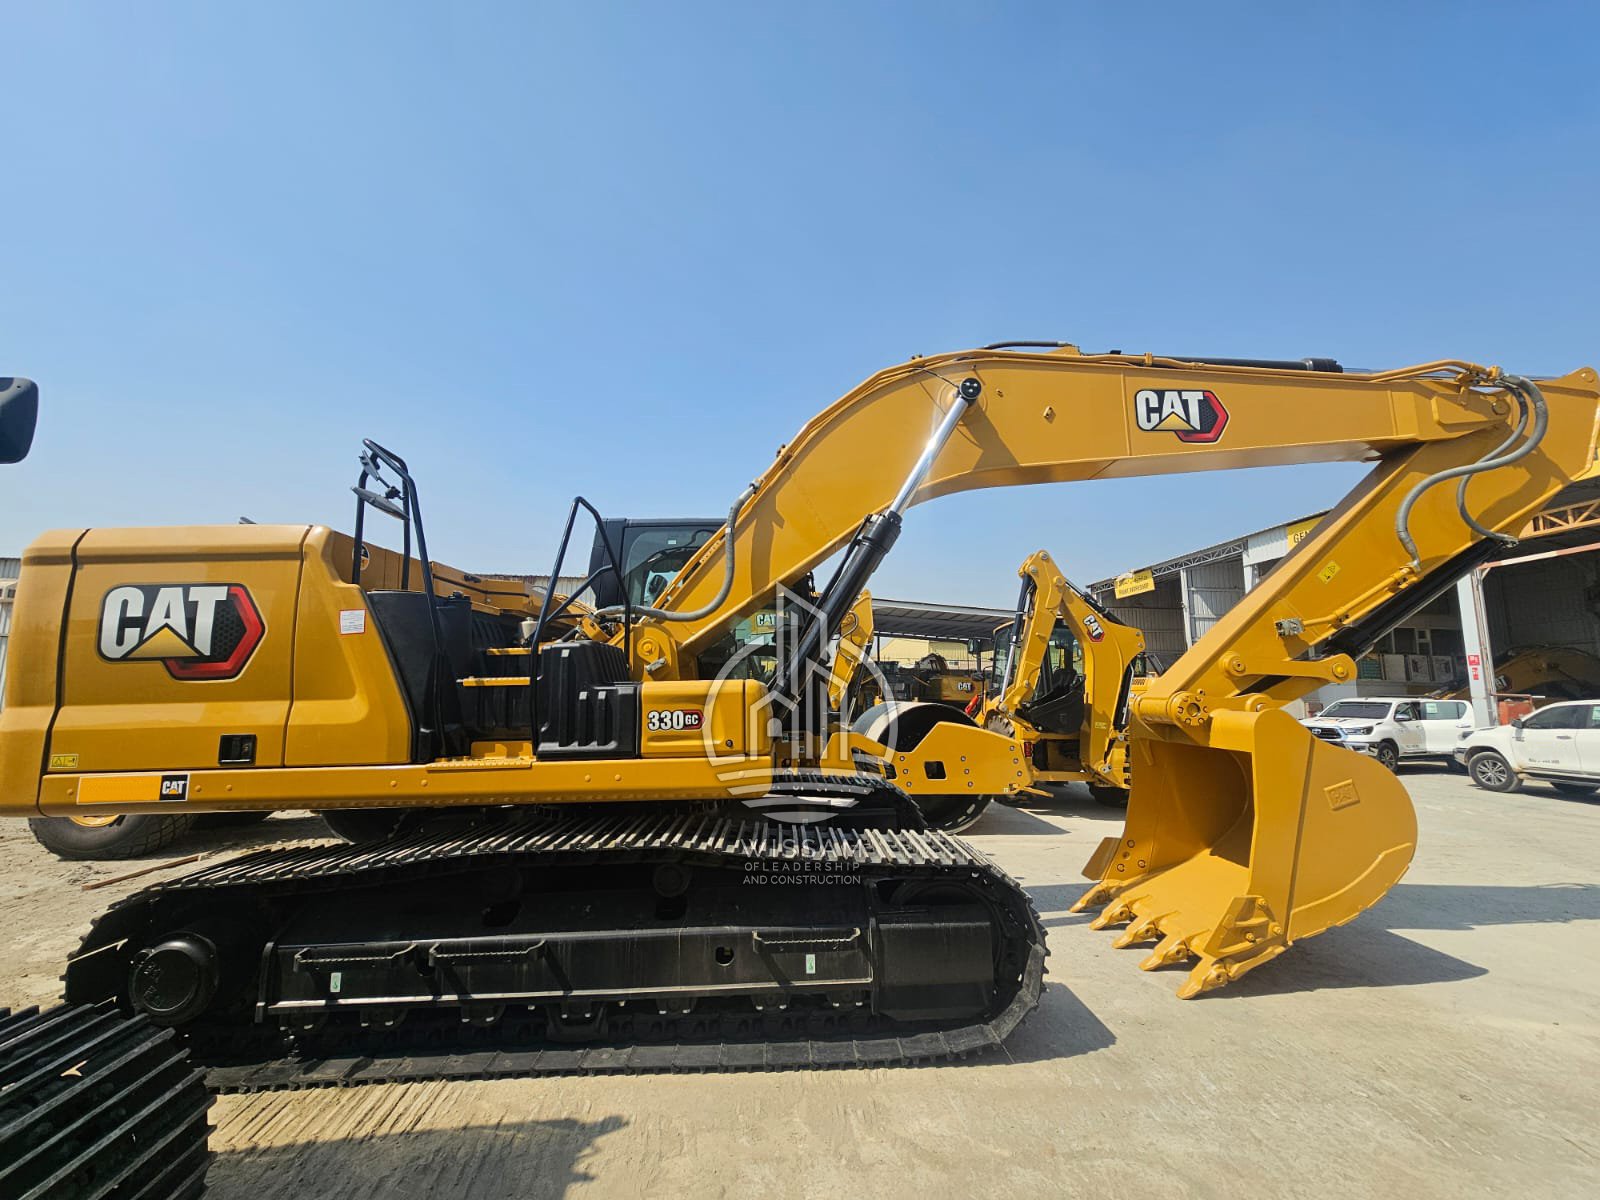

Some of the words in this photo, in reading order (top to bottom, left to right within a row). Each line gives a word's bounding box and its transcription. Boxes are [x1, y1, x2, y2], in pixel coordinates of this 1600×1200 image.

[1136, 390, 1204, 430] CAT
[100, 586, 228, 658] CAT
[757, 614, 777, 626] CAT
[1083, 614, 1104, 637] CAT
[958, 682, 972, 691] CAT
[648, 710, 684, 730] 330
[685, 714, 699, 725] GC
[162, 780, 185, 795] CAT
